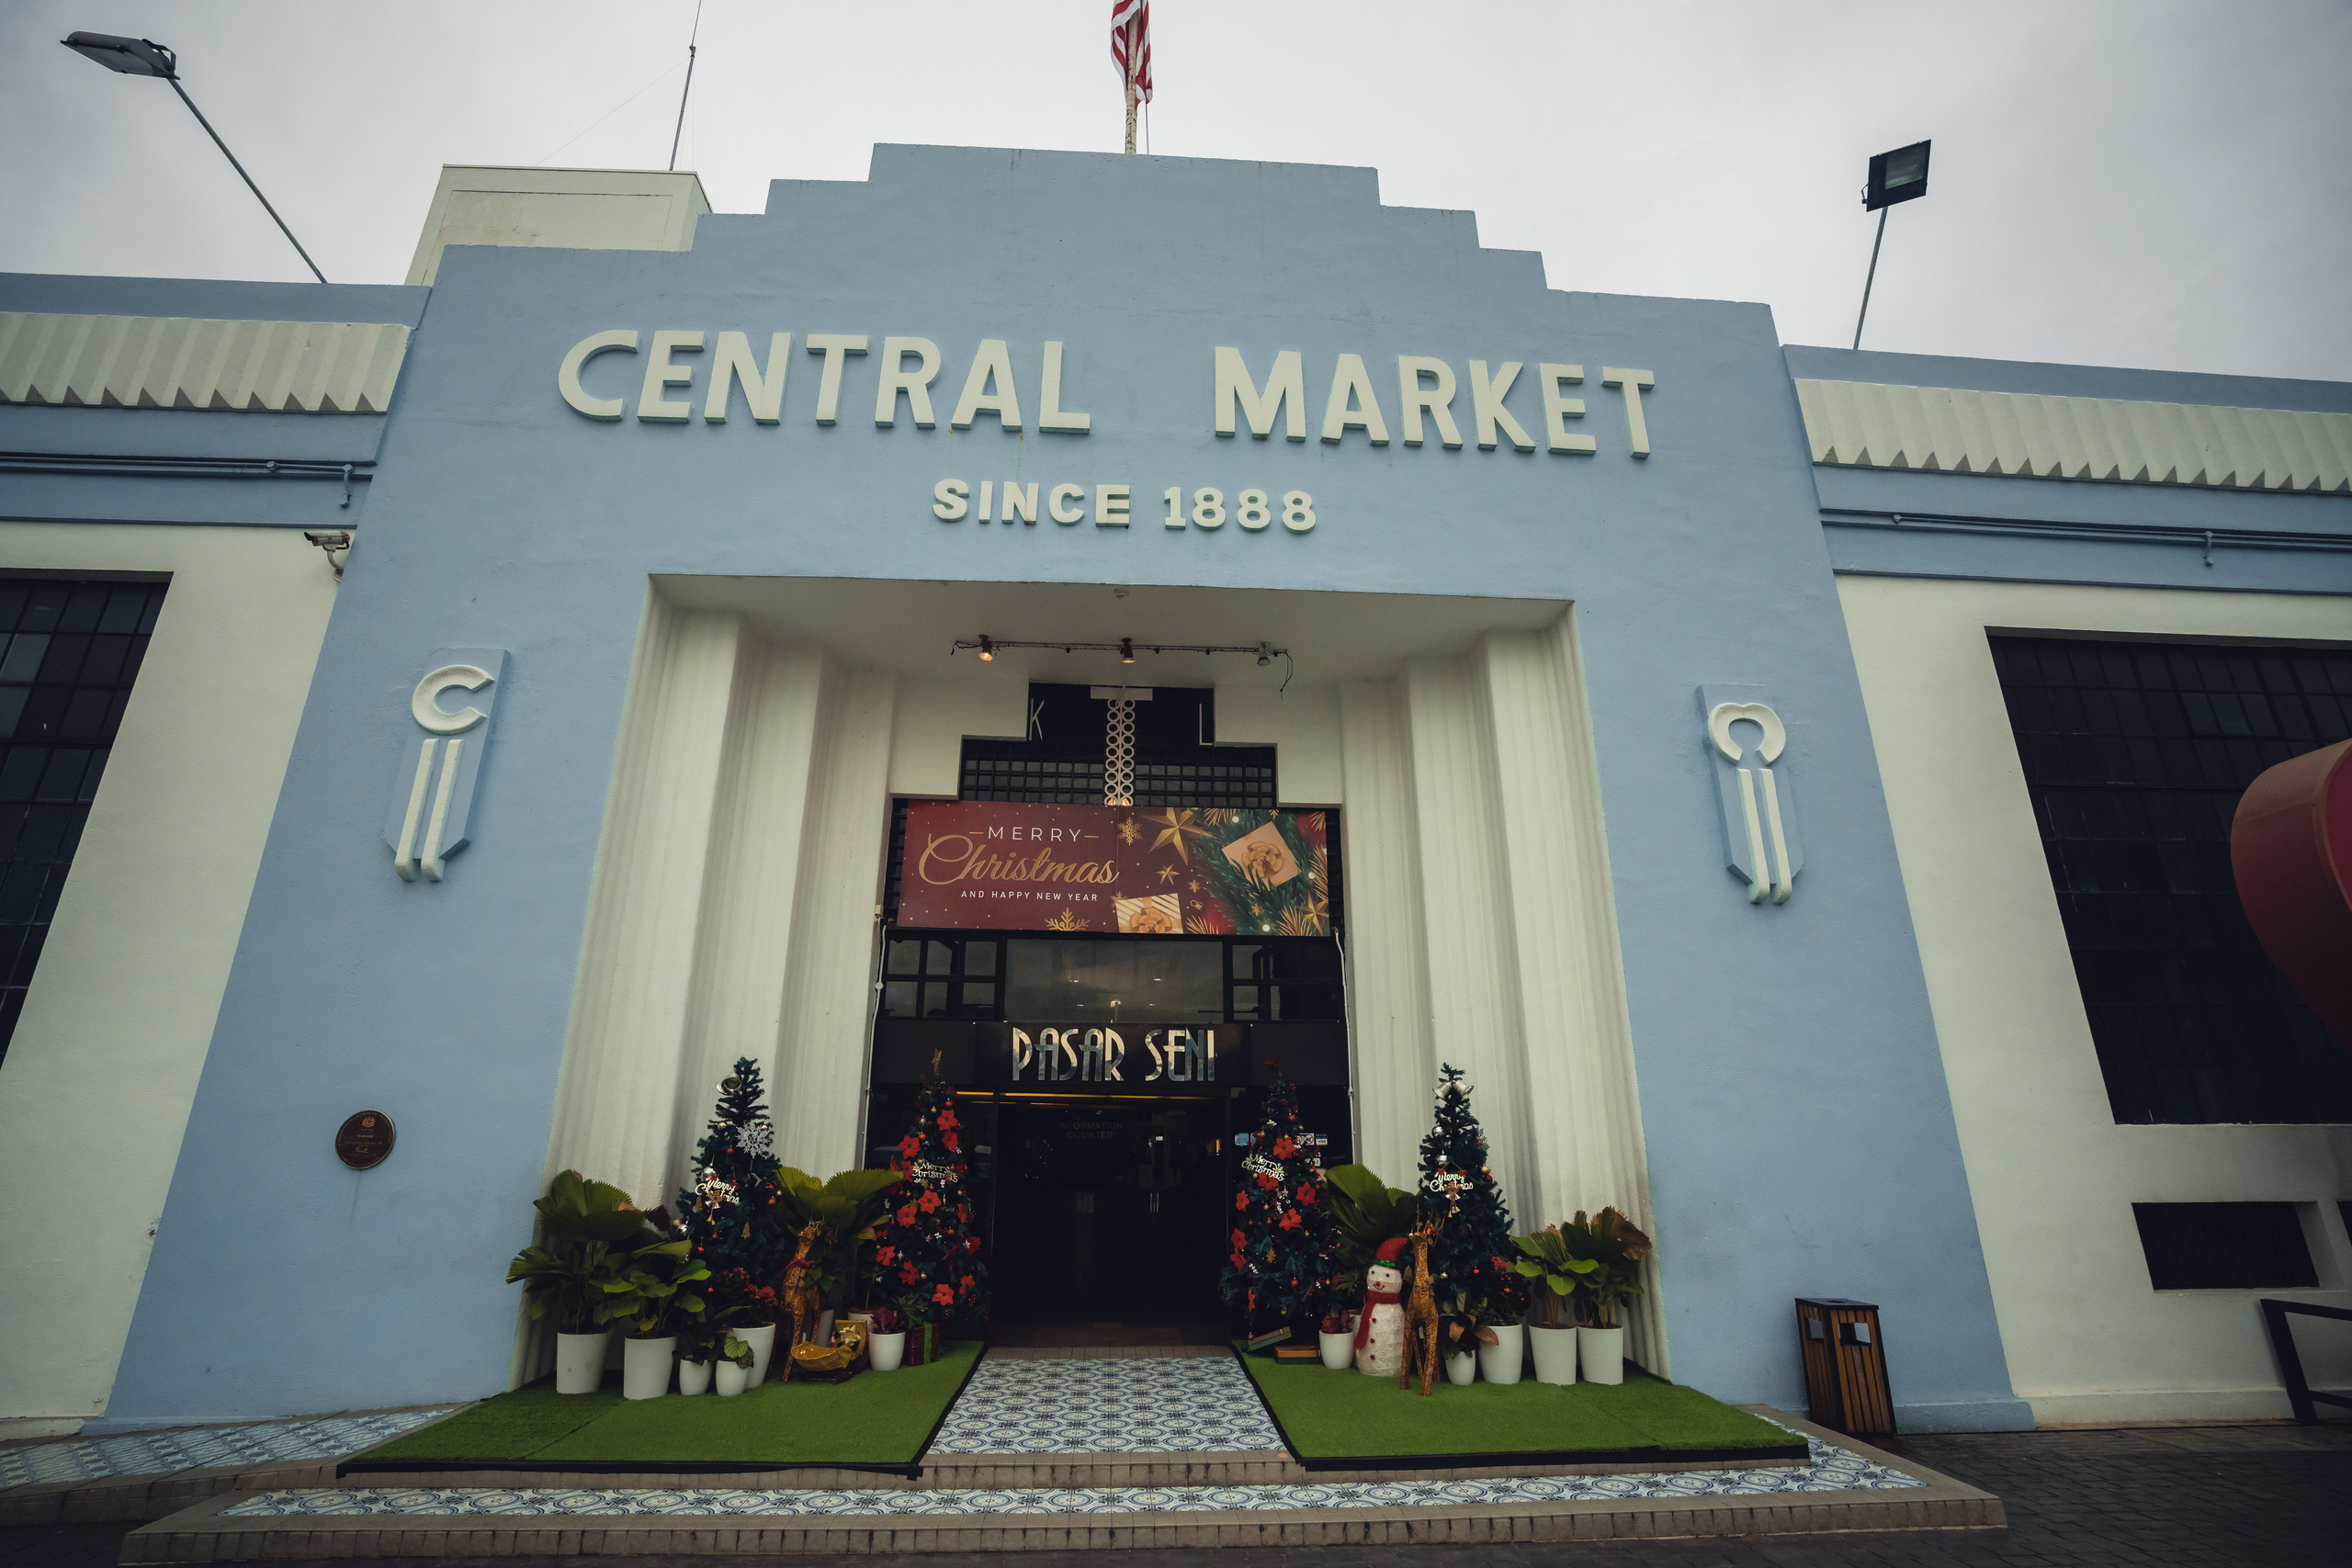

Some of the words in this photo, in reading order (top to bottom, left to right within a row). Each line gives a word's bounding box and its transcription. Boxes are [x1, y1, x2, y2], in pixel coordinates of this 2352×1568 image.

[558, 329, 1091, 434] CENTRAL
[1214, 346, 1655, 458] MARKET
[933, 479, 1131, 528] SINCE
[1163, 487, 1316, 534] 1888
[988, 826, 1081, 841] MERRY
[919, 833, 1120, 885] Christmas
[961, 890, 985, 898] AND
[991, 891, 1030, 899] HAPPY
[1036, 892, 1061, 900] NEW
[1068, 893, 1098, 901] YEAR
[1012, 1027, 1125, 1081] PASAR
[1145, 1027, 1216, 1082] SENI
[1058, 1122, 1124, 1130] INFORMATION
[1067, 1131, 1114, 1139] COUNTER
